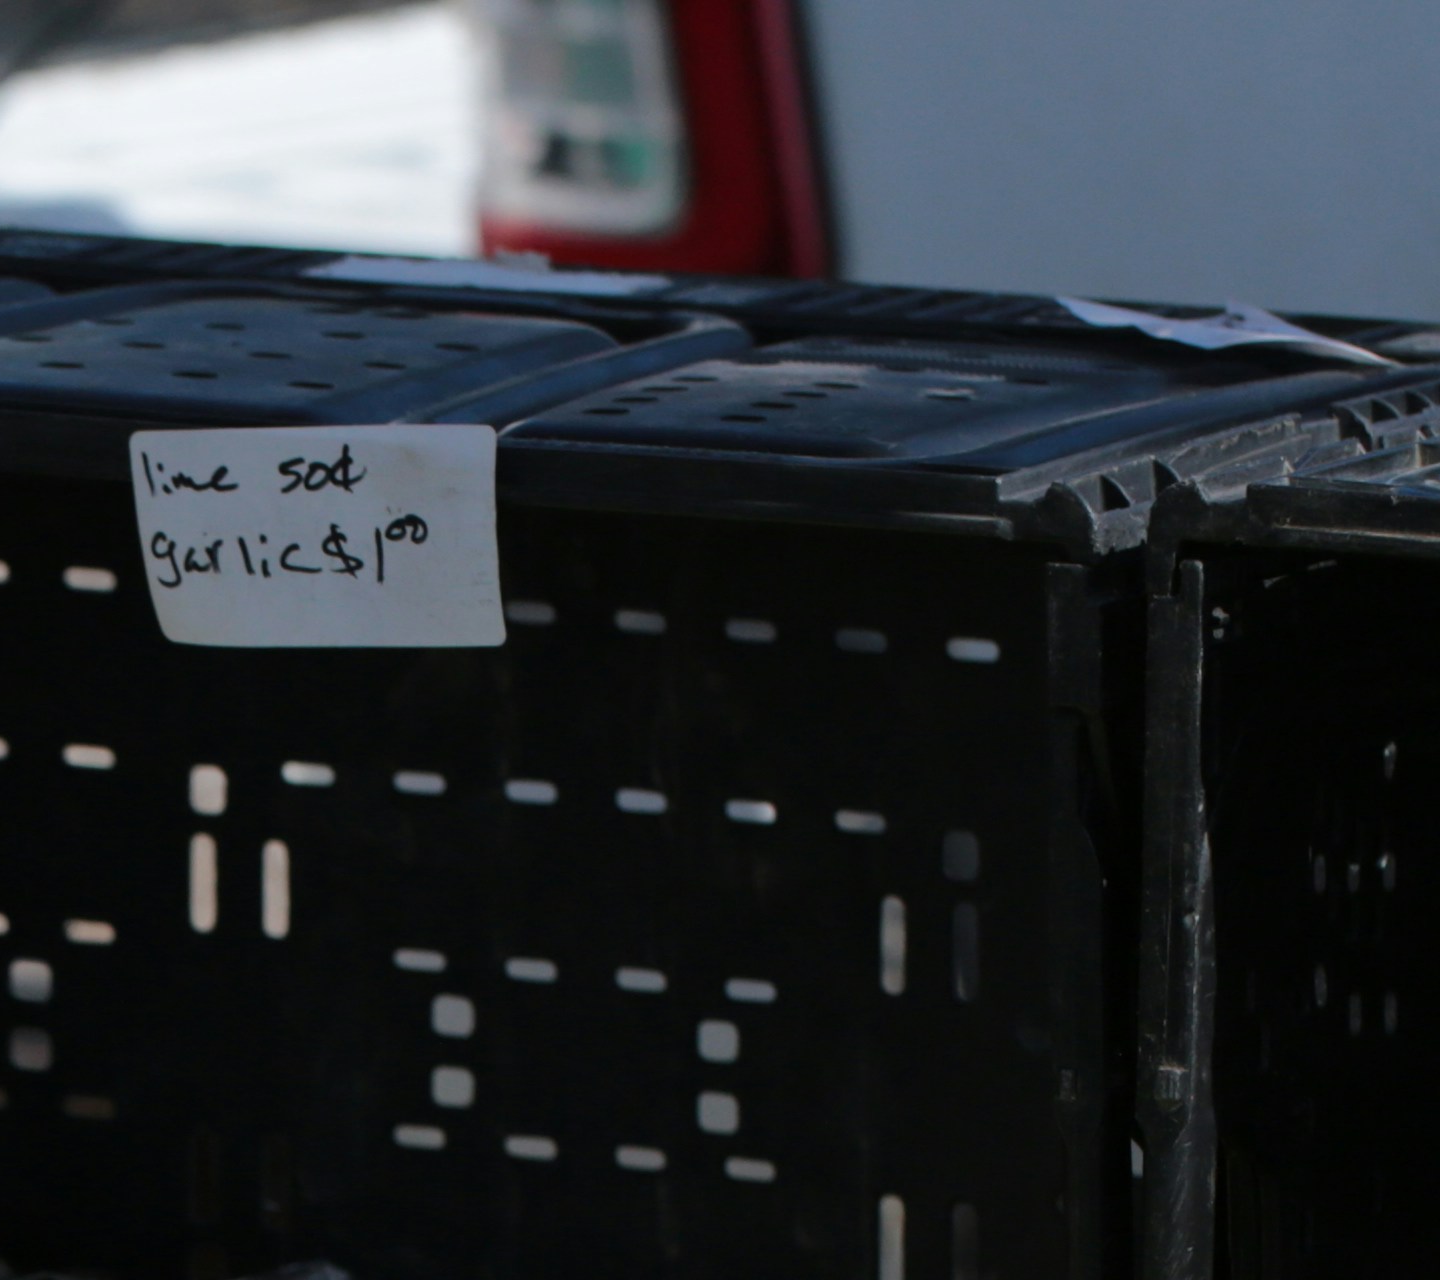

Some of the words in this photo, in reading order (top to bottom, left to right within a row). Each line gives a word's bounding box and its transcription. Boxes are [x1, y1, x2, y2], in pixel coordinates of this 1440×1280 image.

[141, 451, 239, 496] lime
[277, 443, 367, 493] 50¢
[151, 530, 322, 588] garlic
